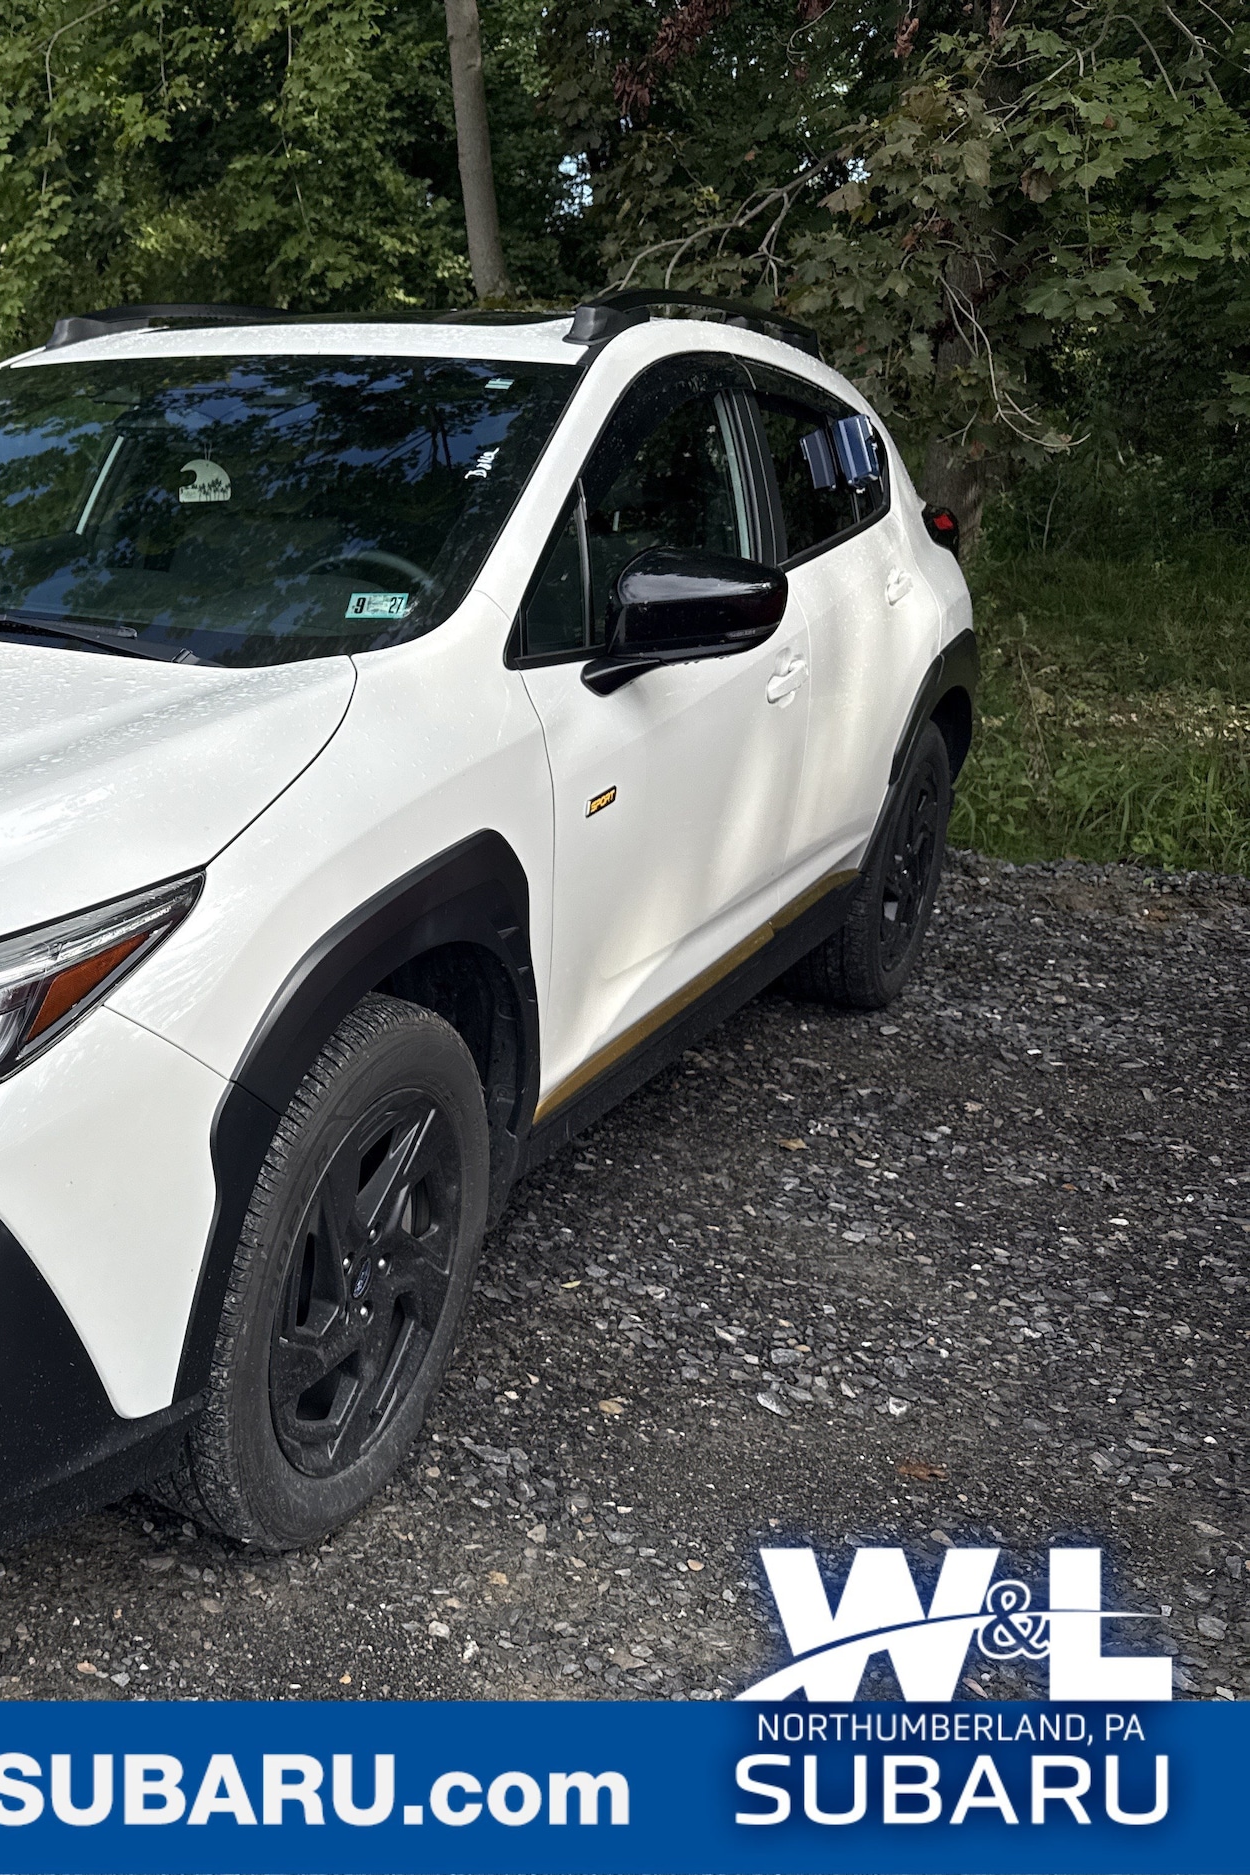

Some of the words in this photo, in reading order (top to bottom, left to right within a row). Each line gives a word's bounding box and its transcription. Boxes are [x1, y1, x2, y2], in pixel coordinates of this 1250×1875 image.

[354, 597, 366, 614] 9
[388, 596, 404, 614] 27
[590, 789, 616, 813] SPORT
